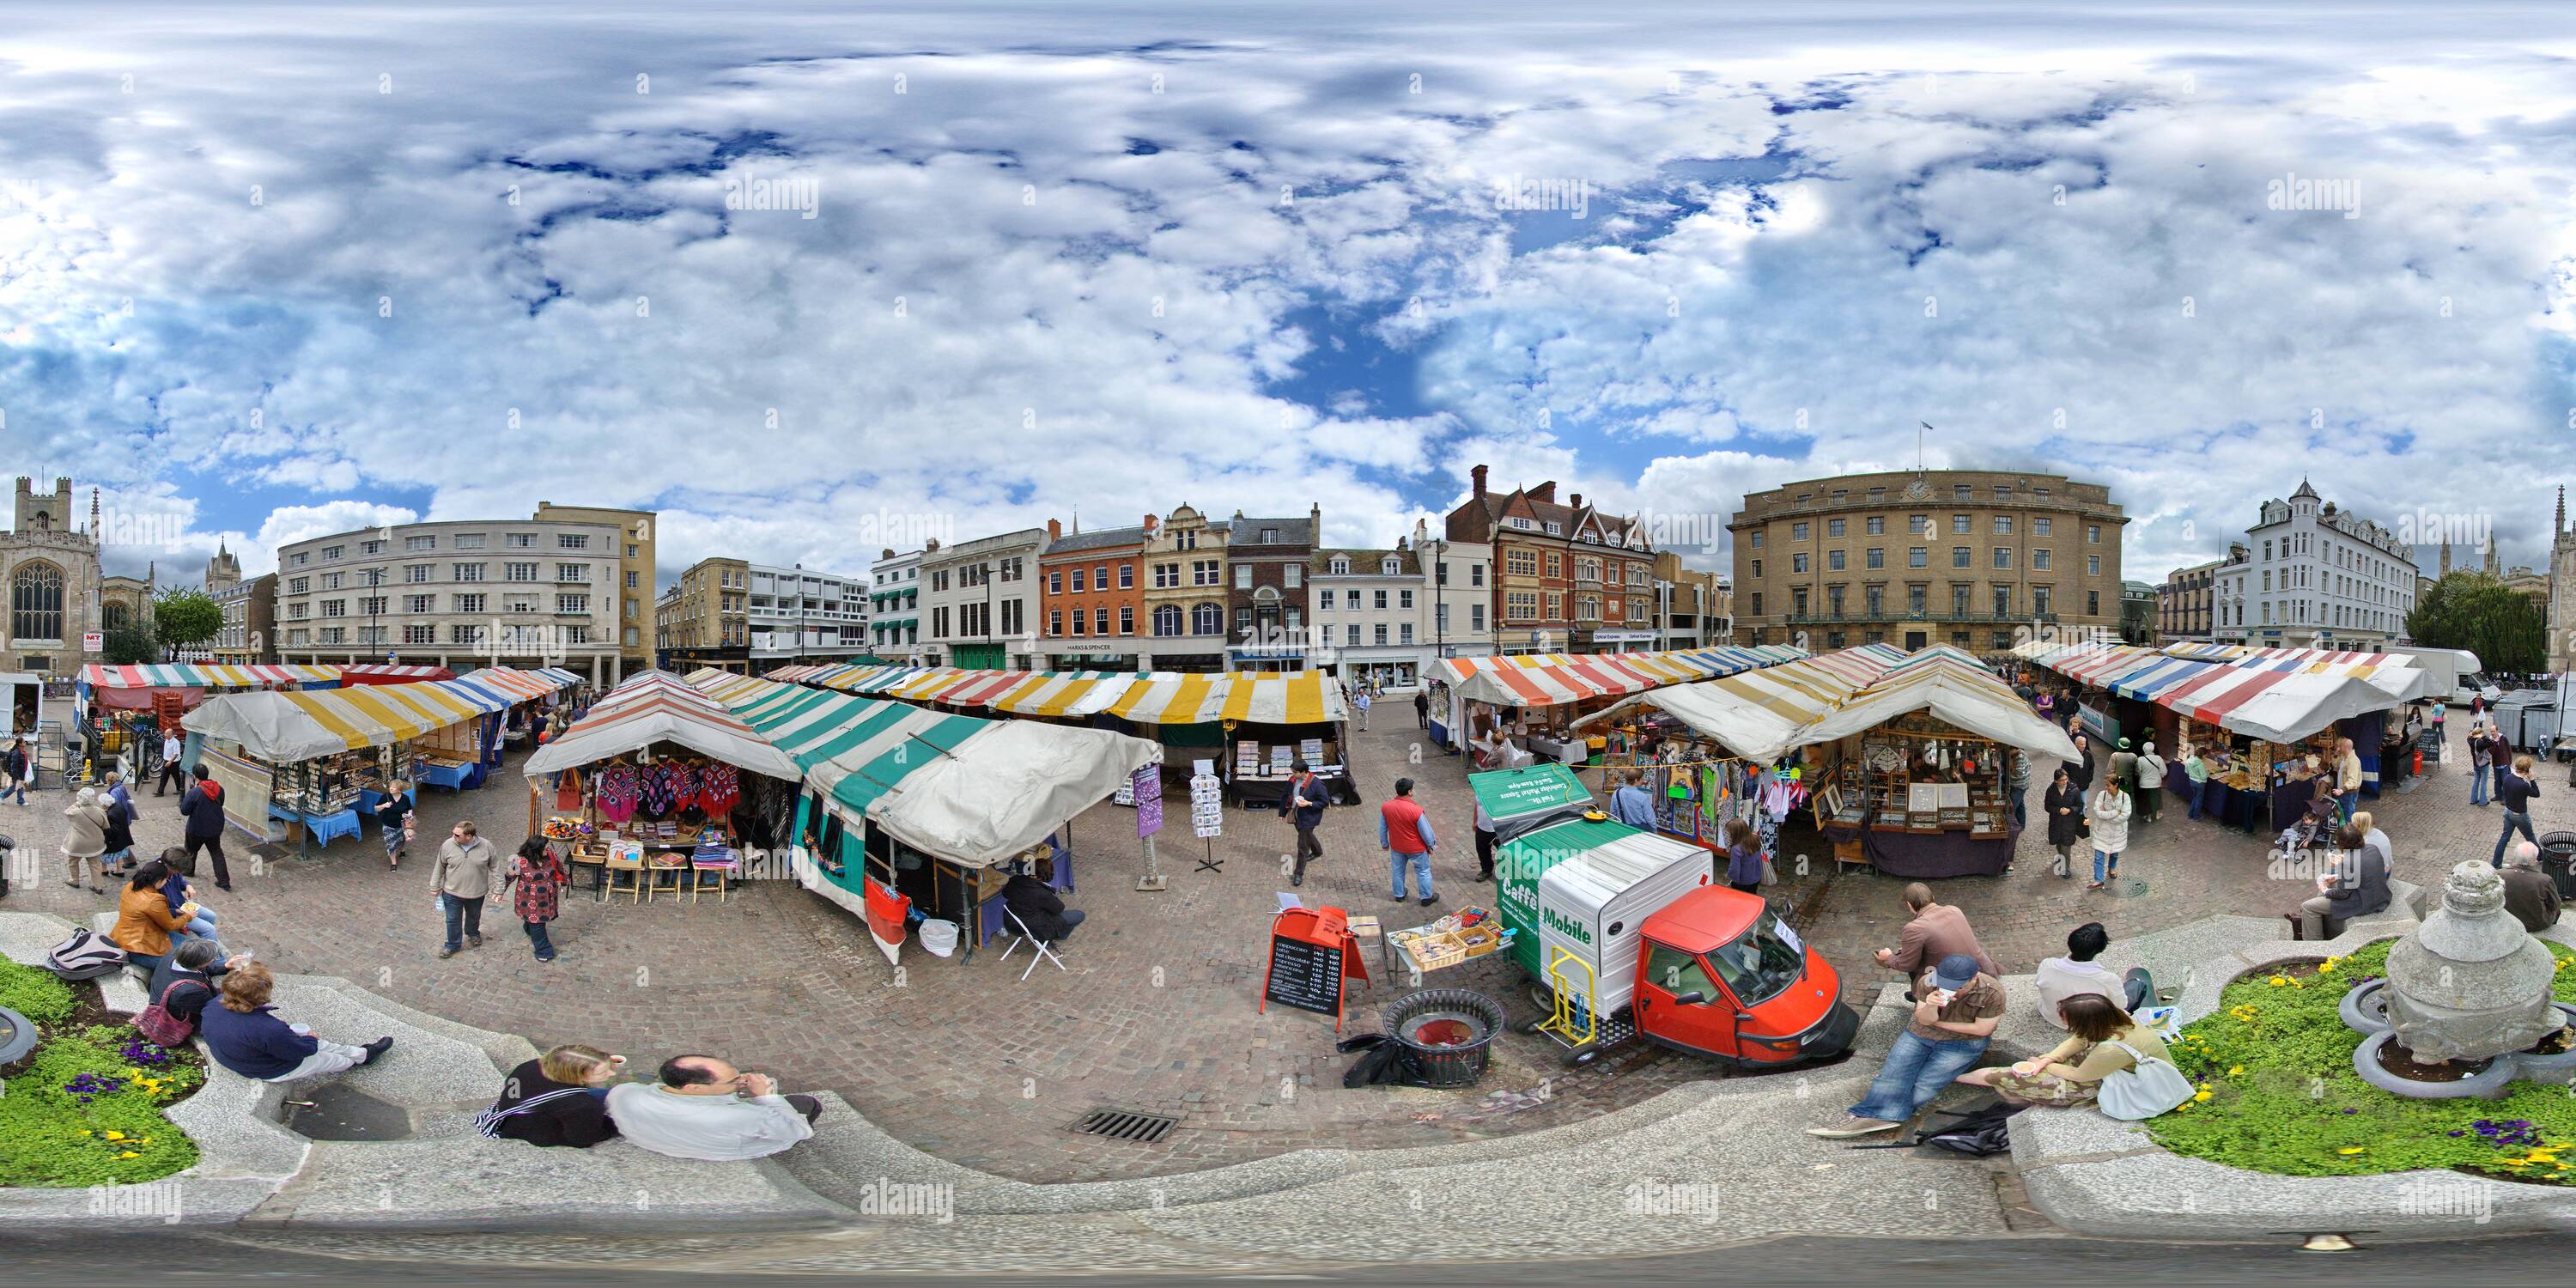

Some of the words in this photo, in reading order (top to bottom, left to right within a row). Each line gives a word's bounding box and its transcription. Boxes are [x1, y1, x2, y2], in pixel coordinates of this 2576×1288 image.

[1543, 906, 1591, 945] Mobile
[1276, 942, 1307, 952] cappuccino
[1275, 957, 1300, 967] espresso
[1285, 955, 1310, 964] chocolate
[1274, 963, 1303, 973] americano
